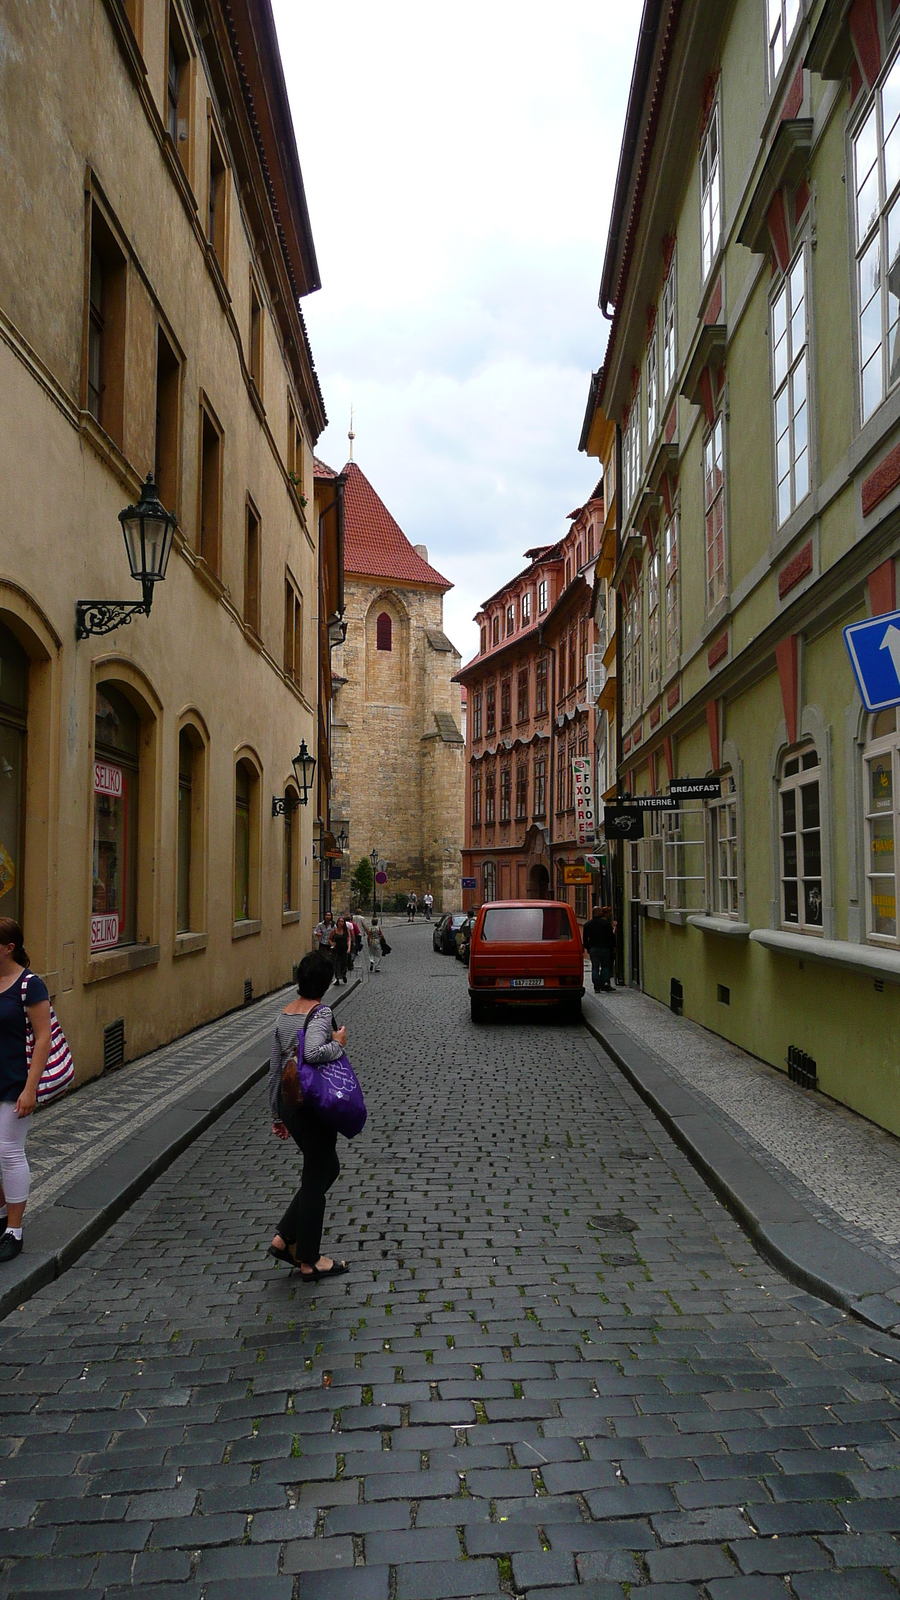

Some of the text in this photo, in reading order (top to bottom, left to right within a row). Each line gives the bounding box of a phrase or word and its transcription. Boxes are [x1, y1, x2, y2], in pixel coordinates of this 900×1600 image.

[95, 765, 120, 792] SELIKO
[671, 784, 719, 793] BREAKFAST
[576, 774, 585, 844] EXPRES
[584, 774, 592, 819] FOTO
[871, 839, 894, 852] CHANG
[91, 918, 117, 944] SELIKO
